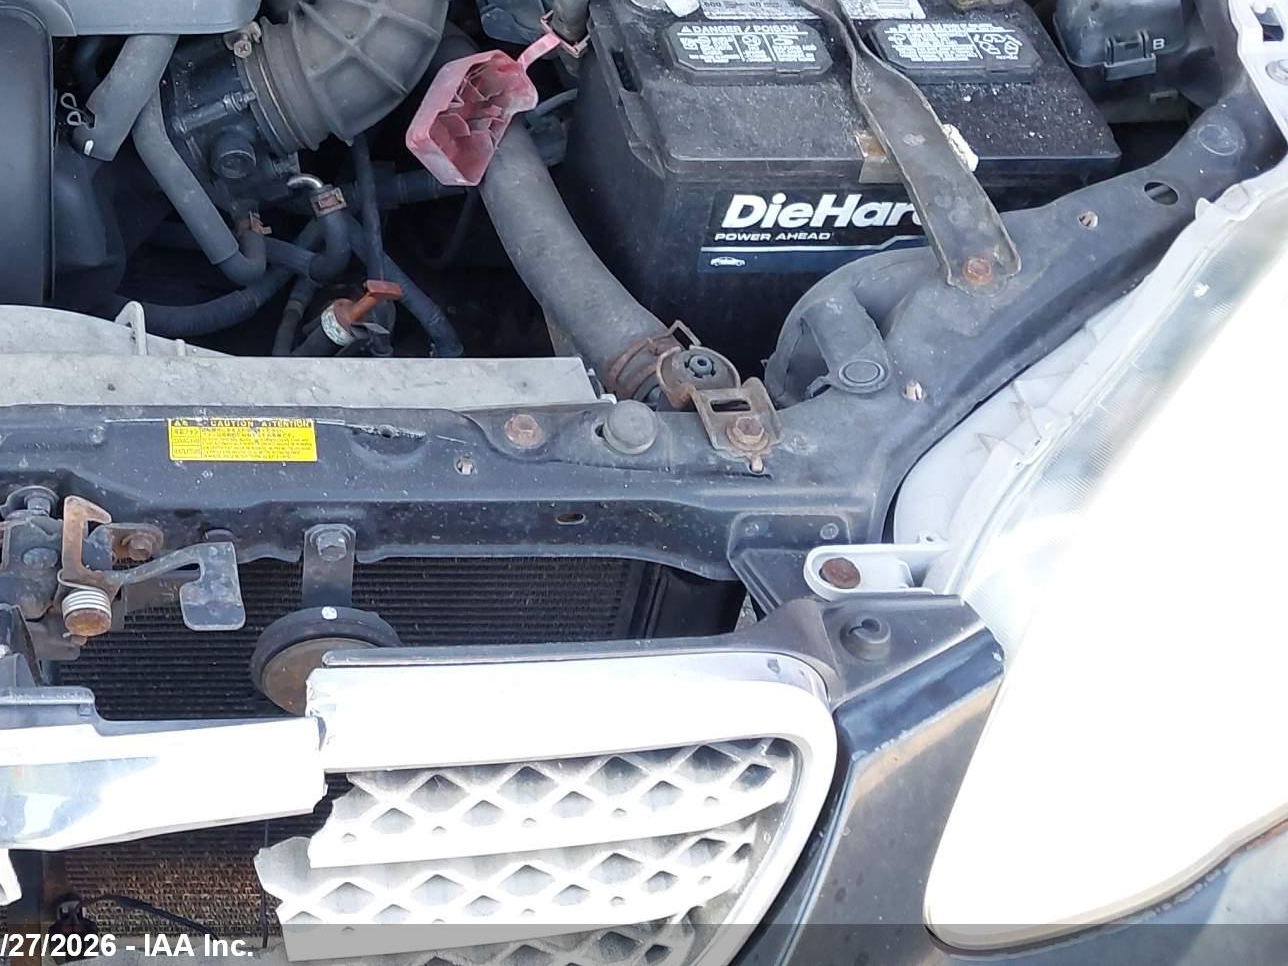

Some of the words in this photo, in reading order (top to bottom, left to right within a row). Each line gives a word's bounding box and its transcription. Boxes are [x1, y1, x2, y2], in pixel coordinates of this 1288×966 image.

[1153, 38, 1165, 50] B
[715, 233, 771, 242] POWER
[775, 232, 831, 241] AHEAD
[210, 419, 254, 427] CAUTION
